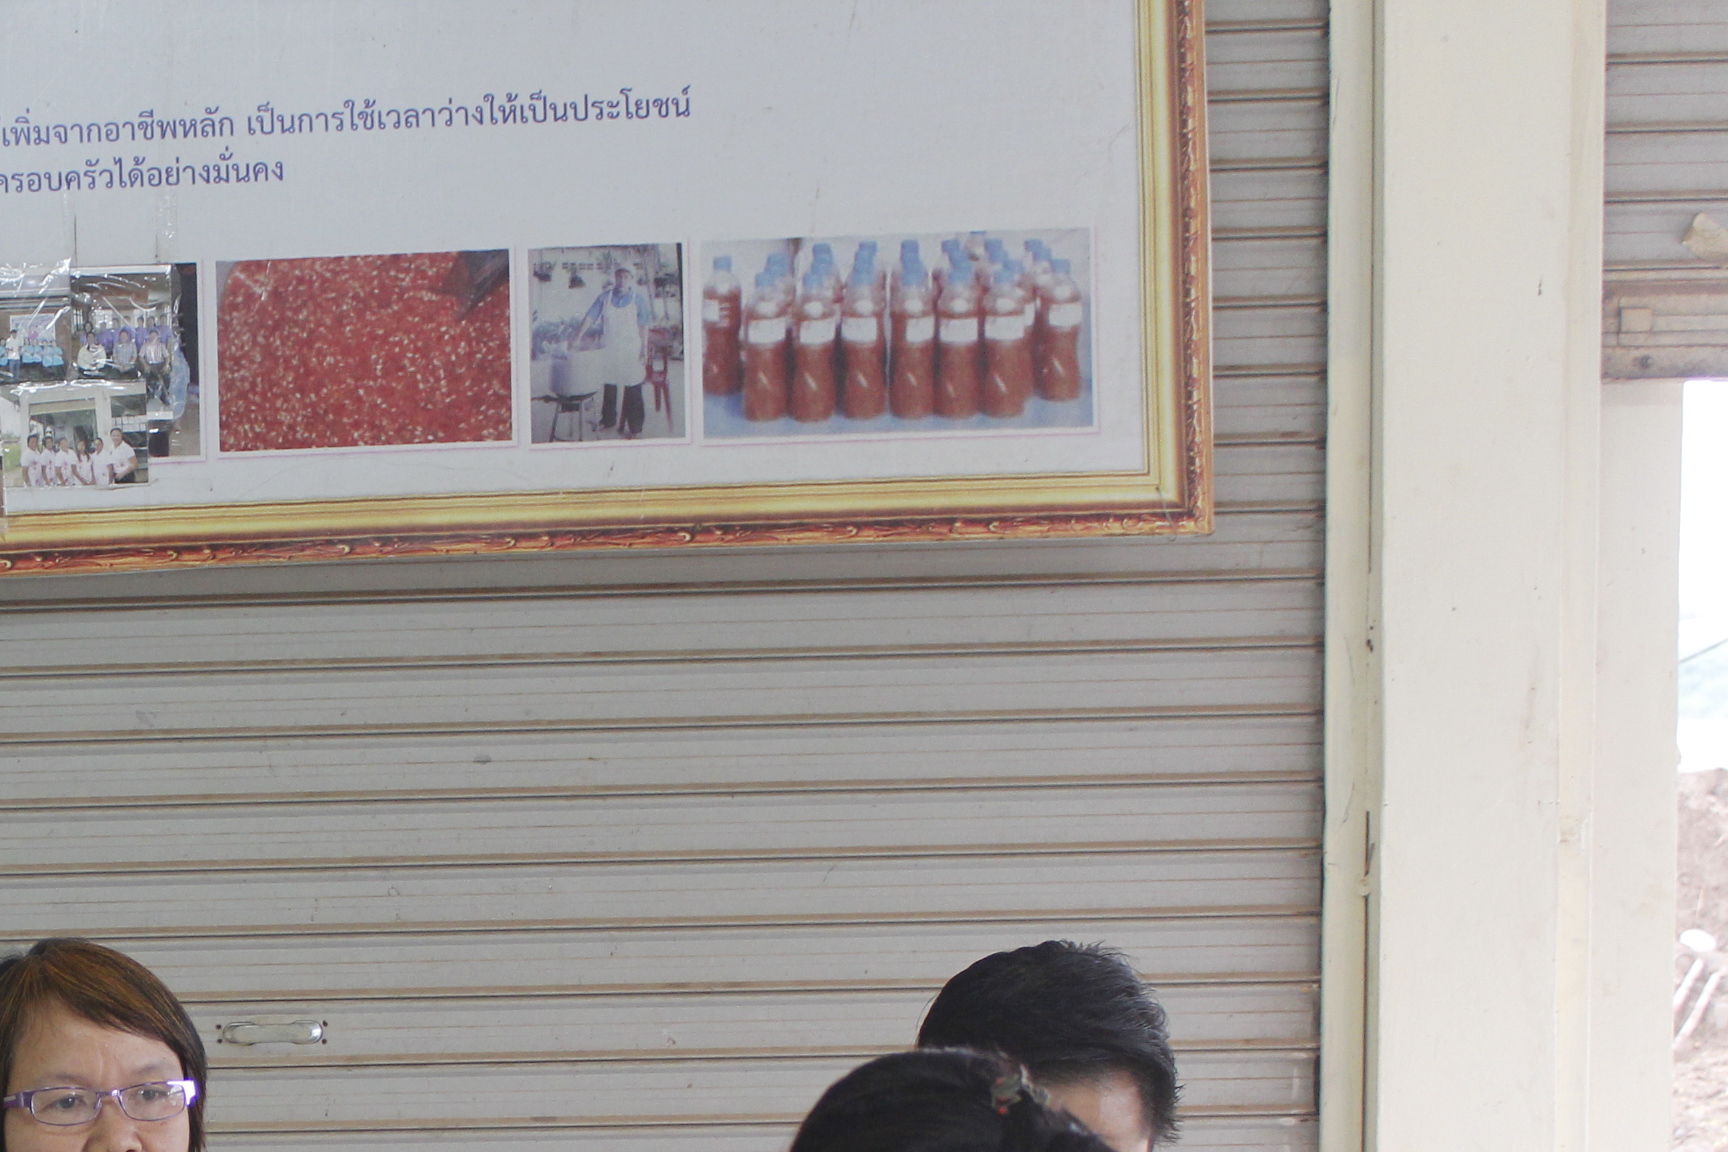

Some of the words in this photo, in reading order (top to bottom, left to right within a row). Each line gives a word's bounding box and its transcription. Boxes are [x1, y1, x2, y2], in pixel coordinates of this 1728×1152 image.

[247, 84, 691, 136] เป็นการใช้เวลาว่างให้เป็นประโยชน์
